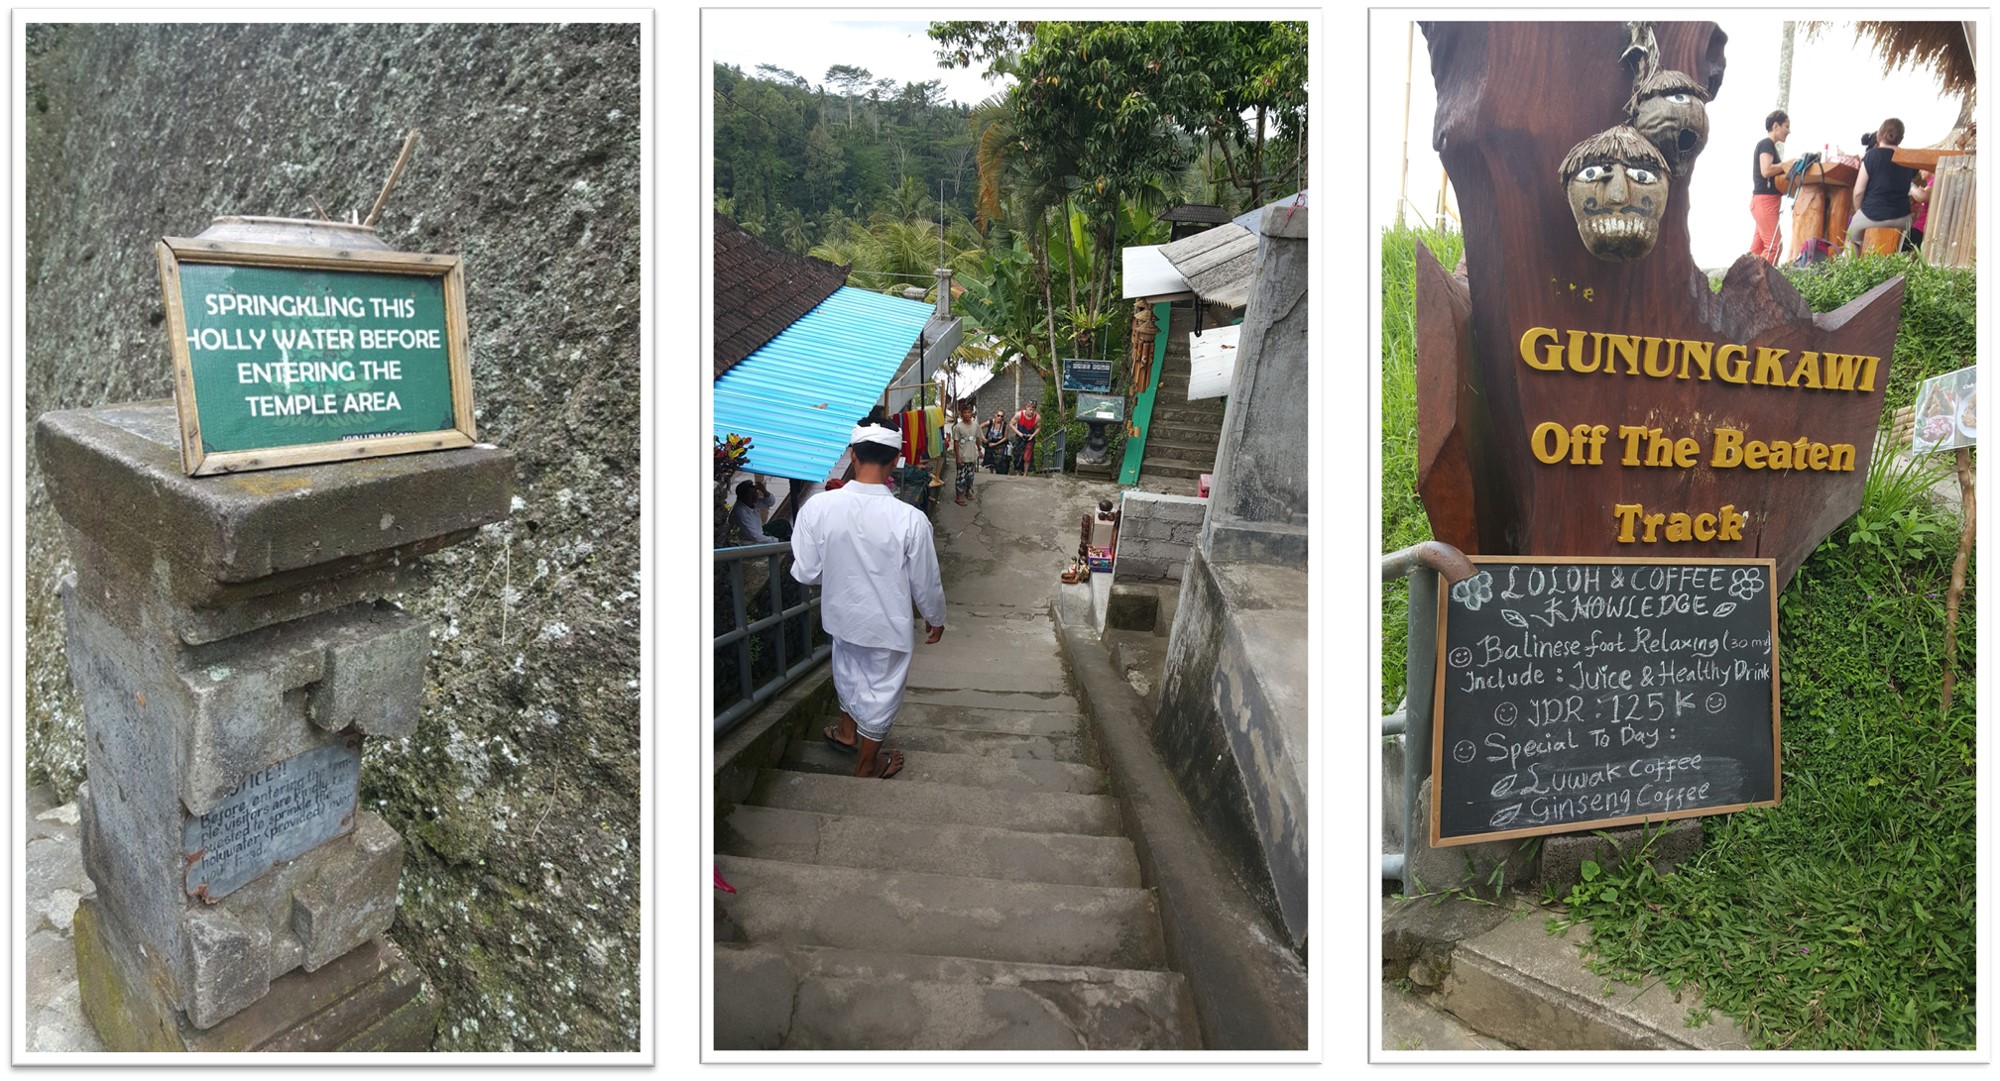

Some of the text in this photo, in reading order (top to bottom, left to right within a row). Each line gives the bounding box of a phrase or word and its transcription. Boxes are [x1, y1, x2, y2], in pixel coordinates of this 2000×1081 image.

[205, 293, 415, 319] SPRINGKLING THIS
[187, 328, 441, 351] HOLLY WATER BEFORE
[237, 360, 402, 384] ENTERING THE
[1519, 326, 1881, 392] GUNUNGKAWI
[245, 391, 402, 417] TEMPLE AREA
[1531, 421, 1857, 472] Off The Beaten
[1613, 503, 1745, 544] Track
[1500, 565, 1727, 600] LOLOH & COFFEE
[1530, 592, 1709, 628] KNOWLEDGE
[1476, 630, 1581, 668] Balinese
[1629, 626, 1720, 658] Relaxing
[1568, 660, 1633, 691] Juice
[1640, 665, 1655, 687] &
[1658, 658, 1732, 687] Healthy
[1734, 658, 1770, 682] Drink
[1610, 692, 1664, 724] 125
[1484, 728, 1579, 770] Special
[1520, 754, 1702, 796] Luwak Coffee
[200, 800, 246, 829] Before
[252, 776, 304, 805] entering
[224, 805, 269, 832] visitors
[273, 795, 291, 811] are
[254, 817, 265, 832] to
[269, 794, 312, 828] sprinkle
[1530, 782, 1710, 824] Ginseng Coffee
